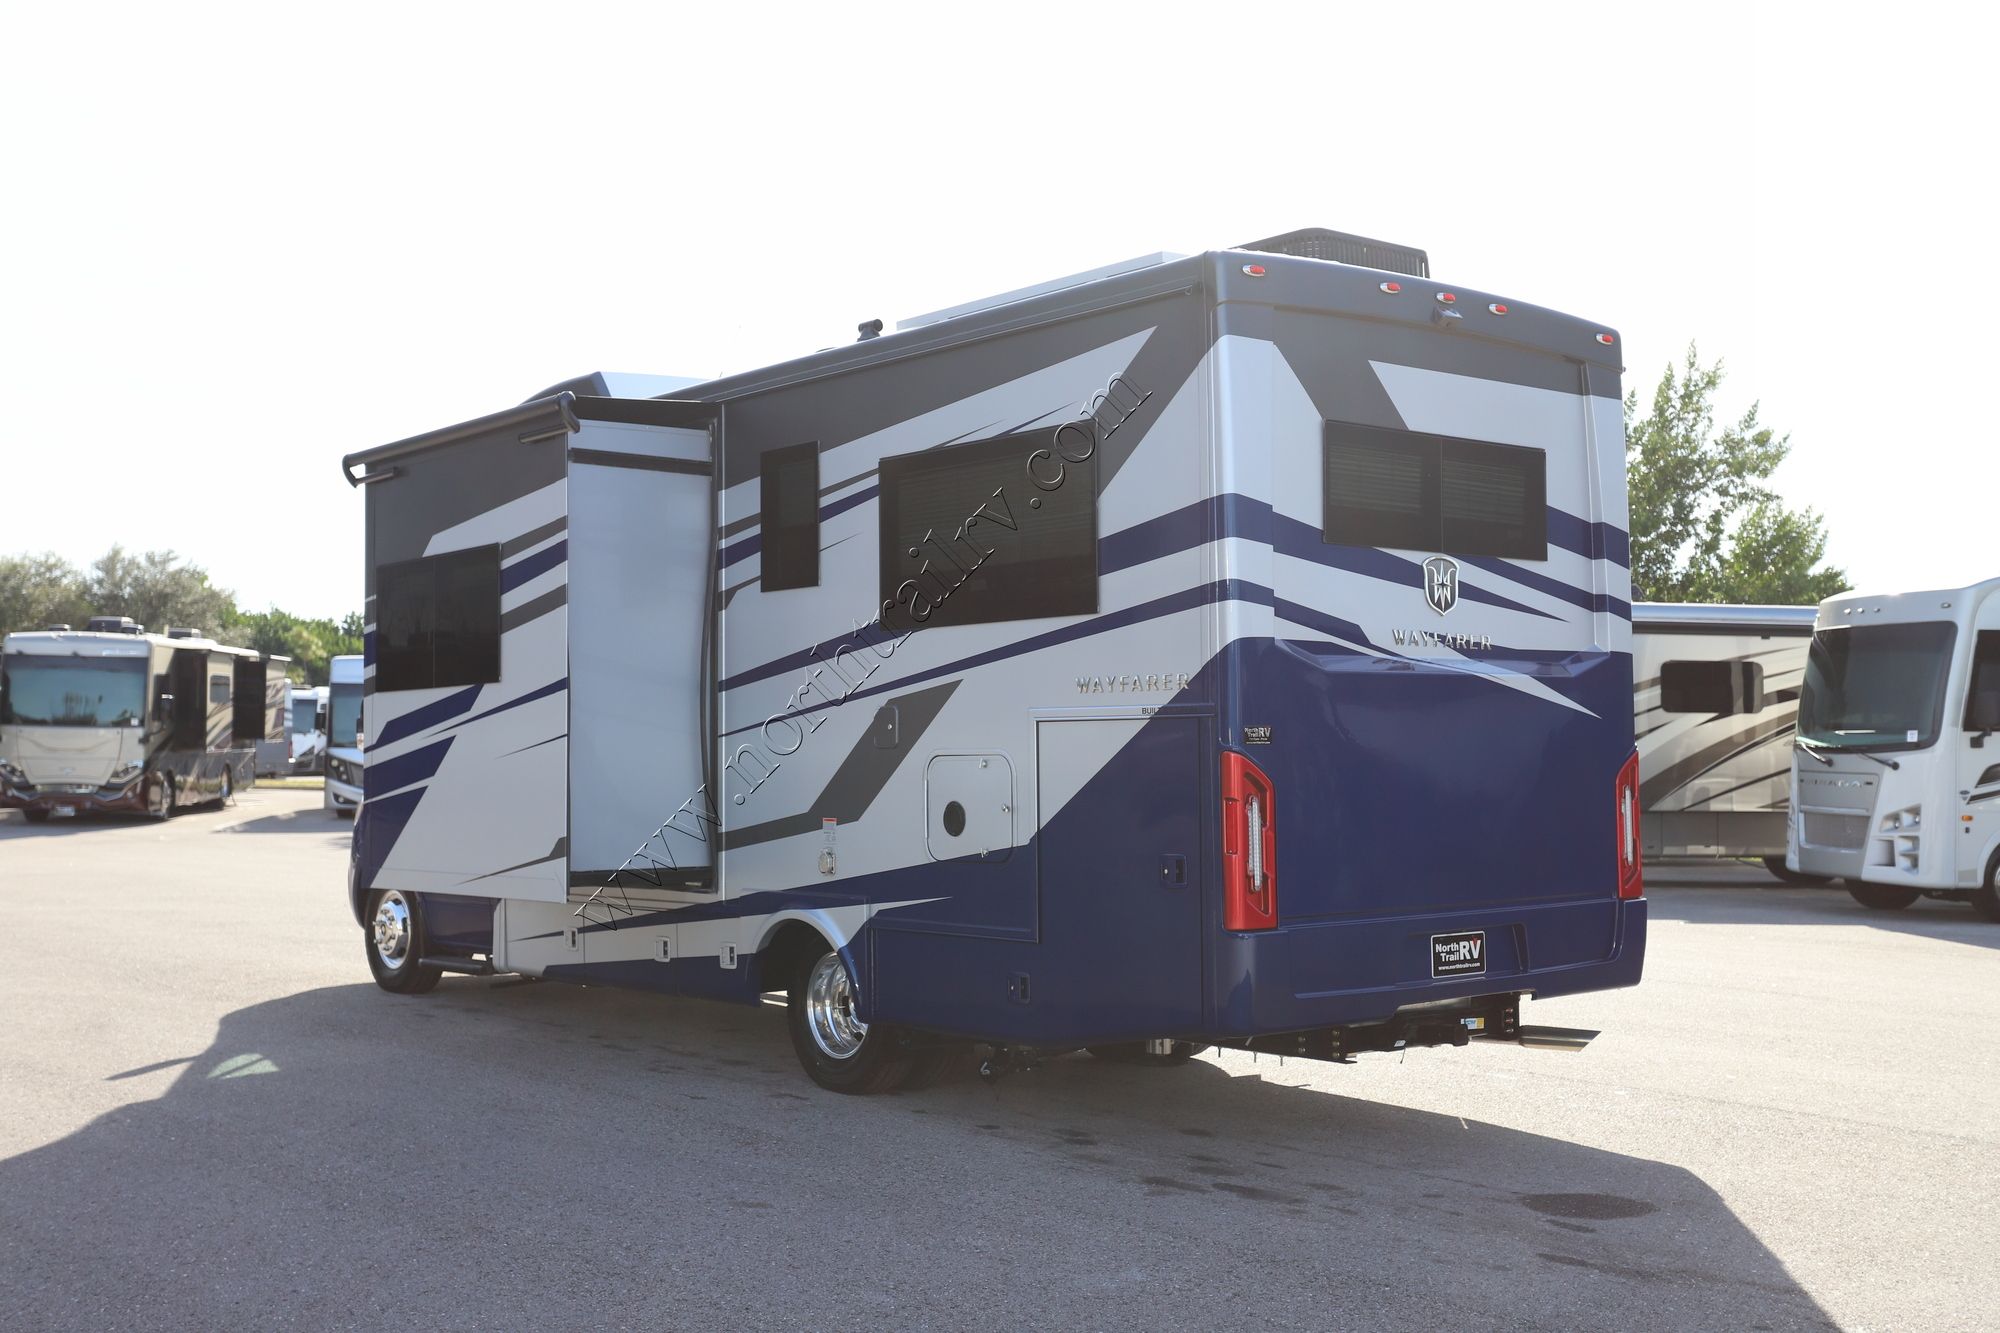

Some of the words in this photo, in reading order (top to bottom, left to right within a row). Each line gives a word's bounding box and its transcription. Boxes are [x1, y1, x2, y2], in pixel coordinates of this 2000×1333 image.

[1391, 629, 1492, 651] WAYFARER
[1075, 673, 1190, 694] WAYFARER
[1435, 942, 1459, 953] North
[1440, 951, 1460, 962] Trail
[1459, 939, 1481, 960] RV
